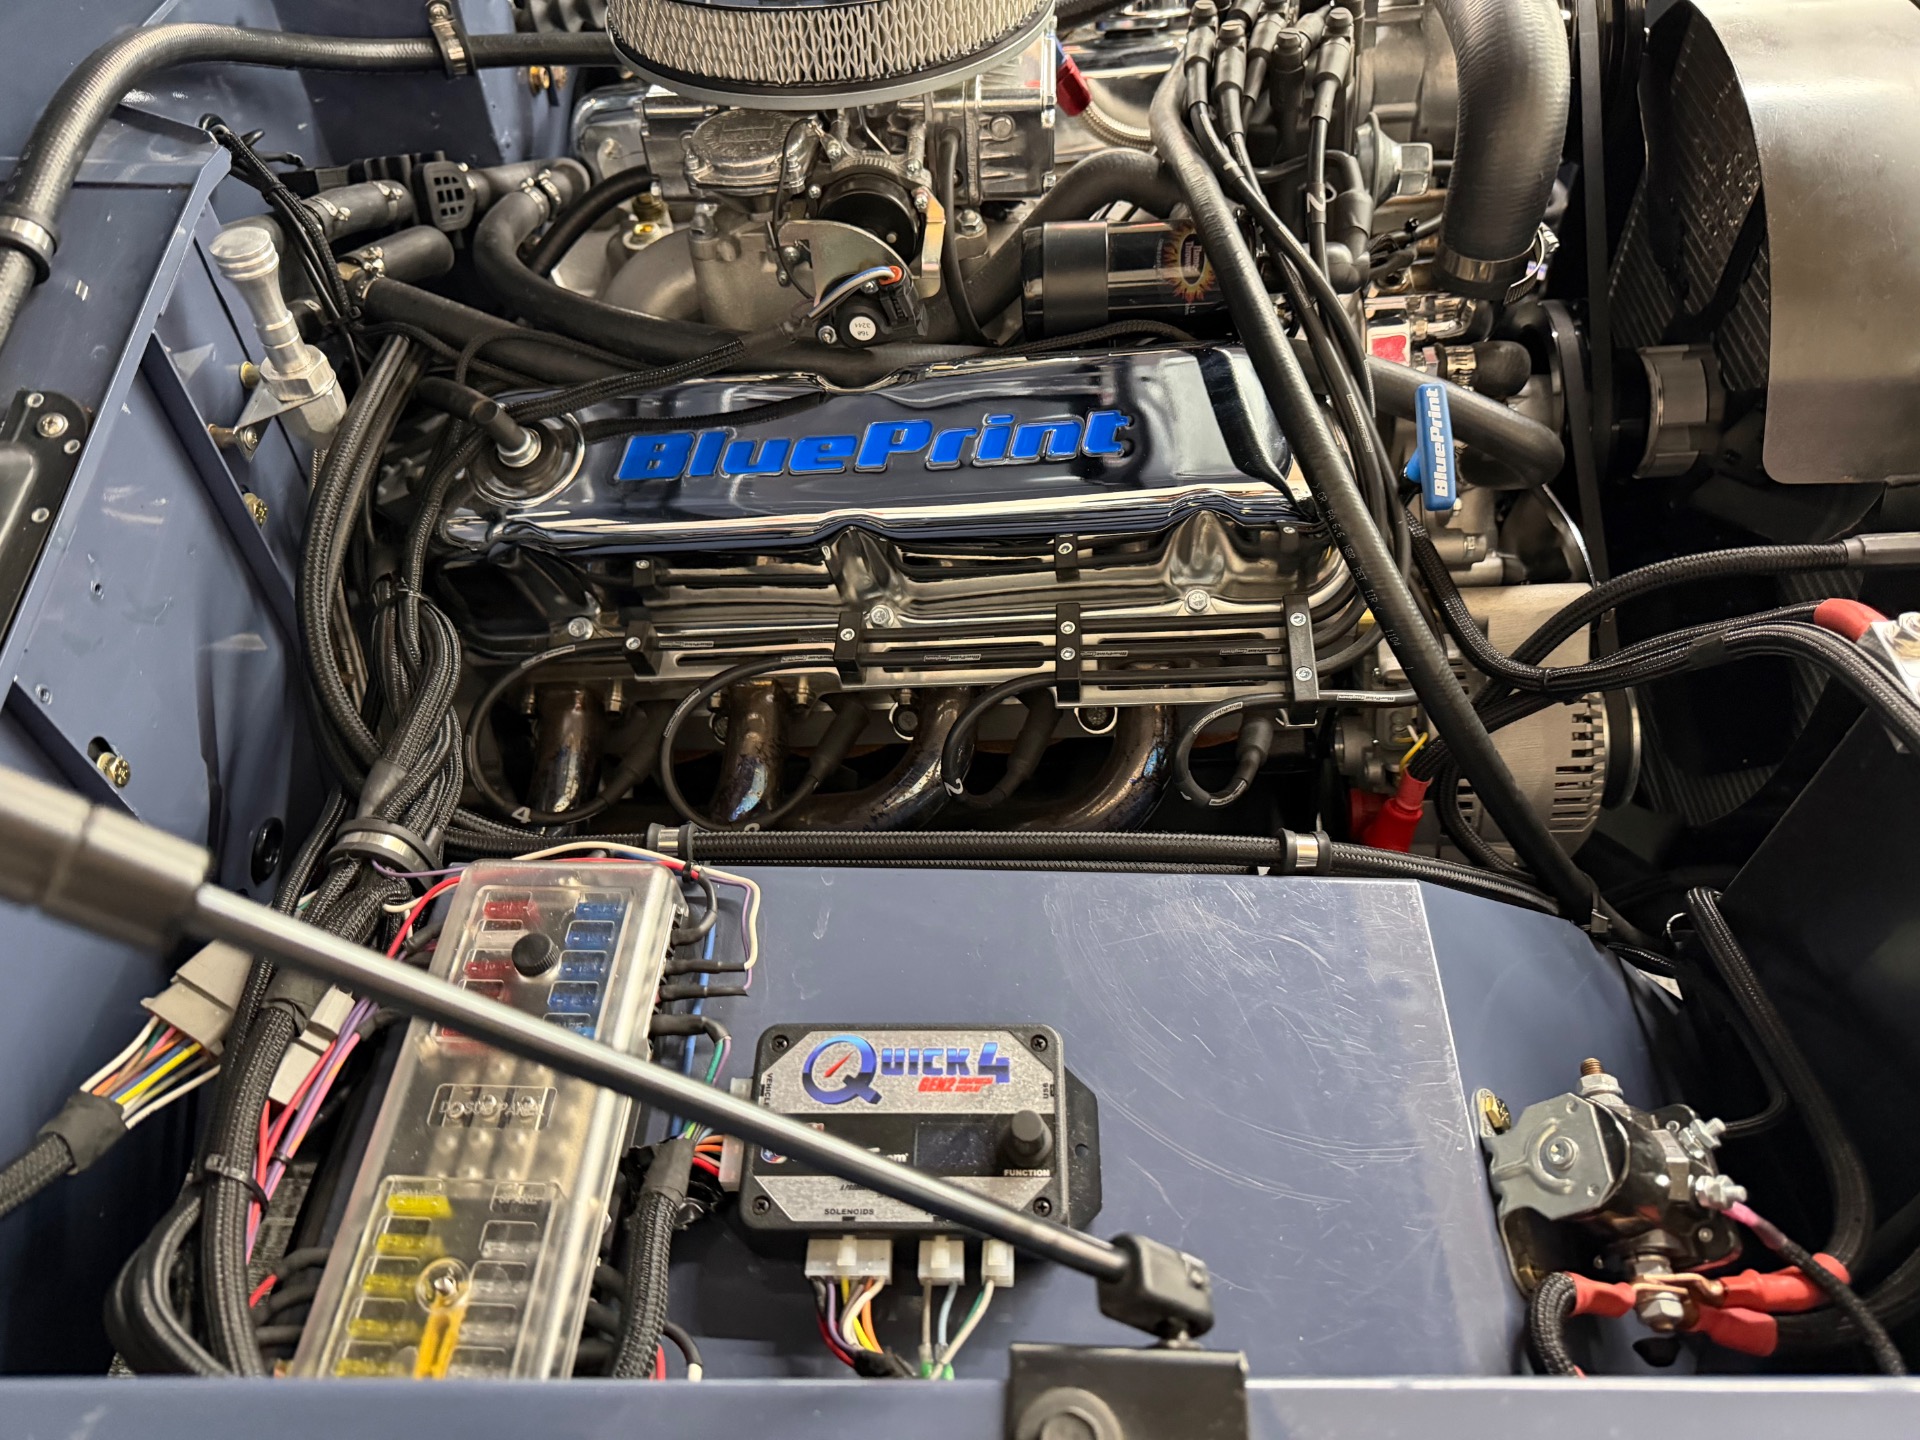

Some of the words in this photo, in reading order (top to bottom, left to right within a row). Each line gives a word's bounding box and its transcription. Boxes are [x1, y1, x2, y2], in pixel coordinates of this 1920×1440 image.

[615, 410, 1129, 481] BluePrint
[1425, 387, 1449, 498] BluePrint
[1316, 491, 1328, 503] CR
[1326, 508, 1336, 521] PA
[1353, 566, 1368, 581] PET
[944, 777, 964, 797] 2
[511, 806, 532, 824] 4
[978, 1042, 1010, 1083] 4
[918, 1077, 956, 1093] GEN2
[1004, 1169, 1050, 1177] FUNCTION
[824, 1208, 875, 1216] SOLENOIDS
